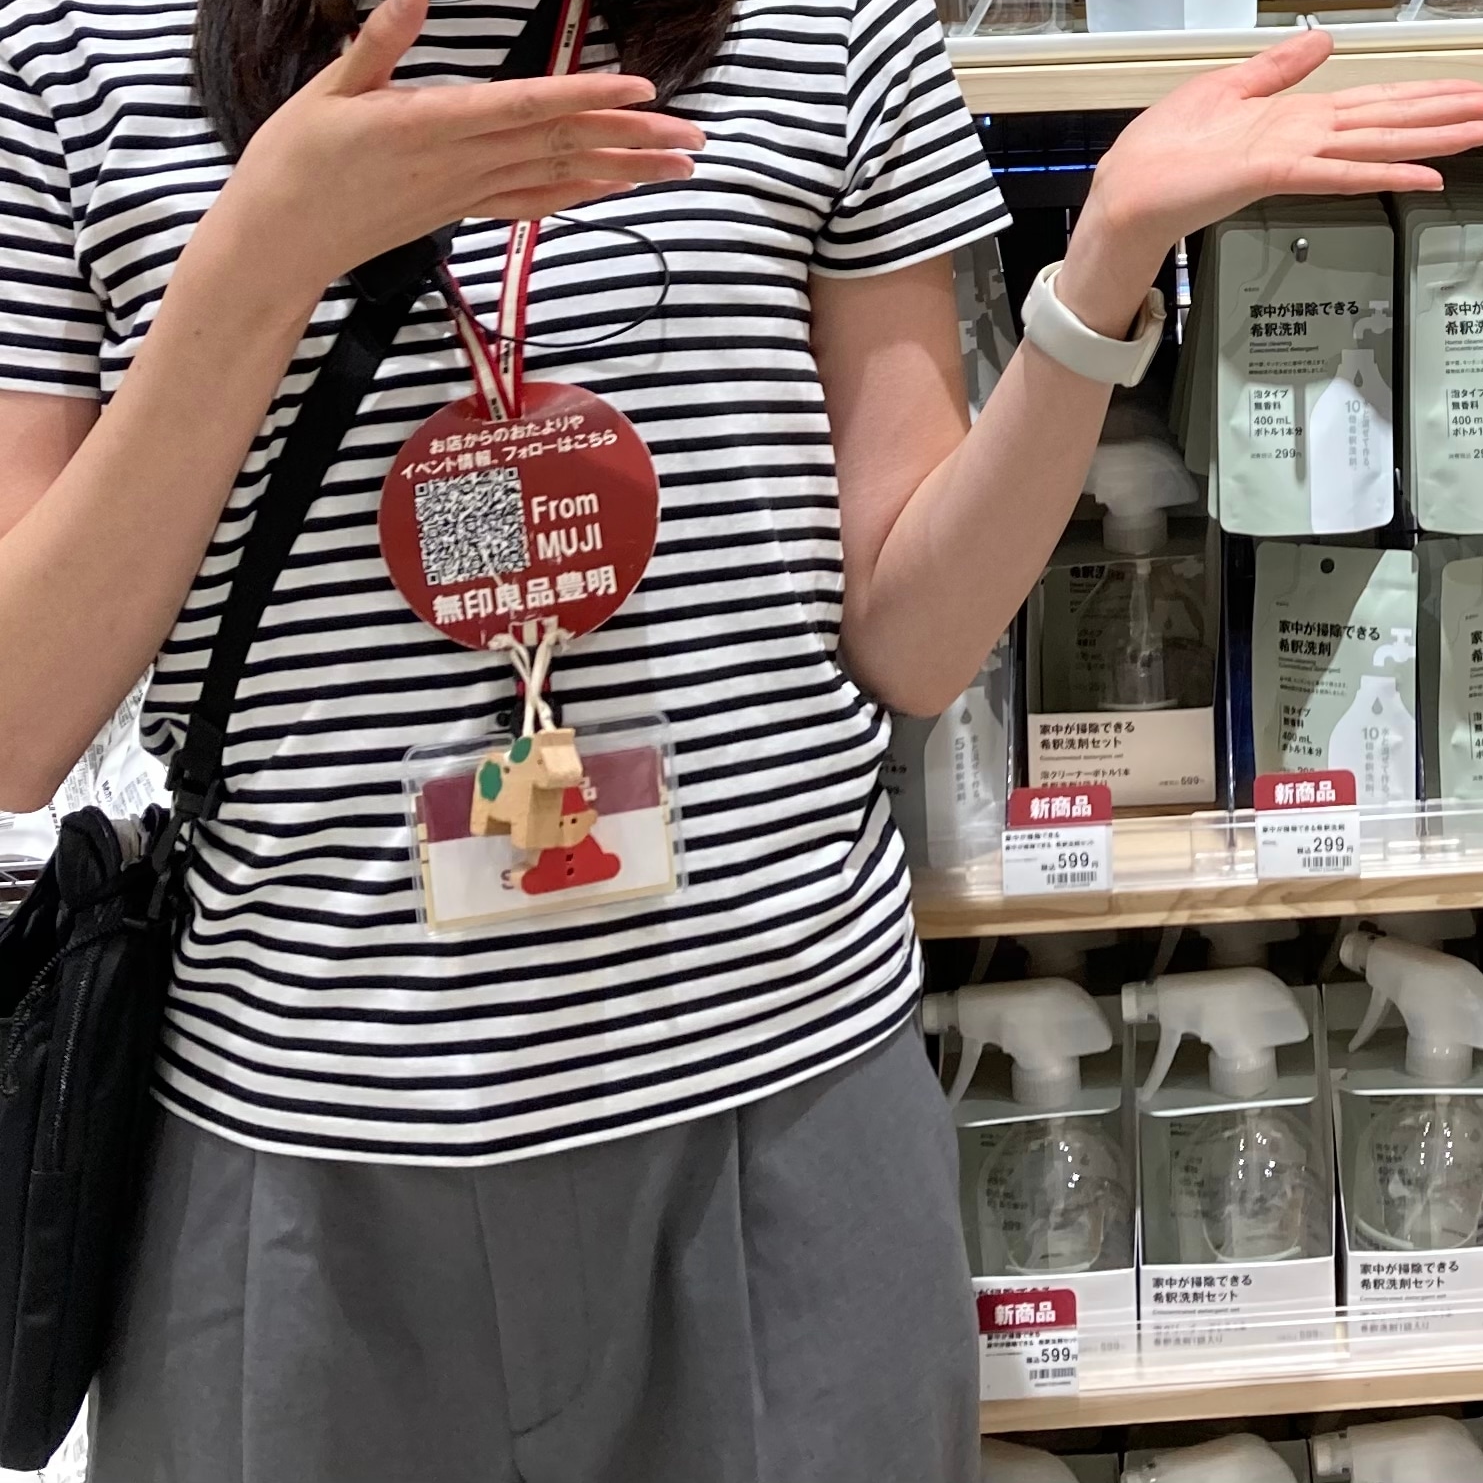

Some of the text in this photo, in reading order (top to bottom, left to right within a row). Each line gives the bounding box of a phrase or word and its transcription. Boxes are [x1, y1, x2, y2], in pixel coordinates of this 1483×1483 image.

[1249, 300, 1359, 318] 家中が掃除できる
[1250, 321, 1307, 337] 希釈洗剤
[1451, 415, 1471, 425] 400
[430, 415, 583, 454] お店からのおたよりや
[531, 493, 599, 525] From
[536, 523, 603, 561] MUJI
[432, 565, 618, 624] 無印良品豊明
[1279, 620, 1380, 641] 家中が掃除できる
[1279, 639, 1332, 656] 希釈洗剤
[1274, 780, 1336, 805] 新商品
[1030, 794, 1092, 819] 新商品
[994, 1301, 1056, 1325] 新商品
